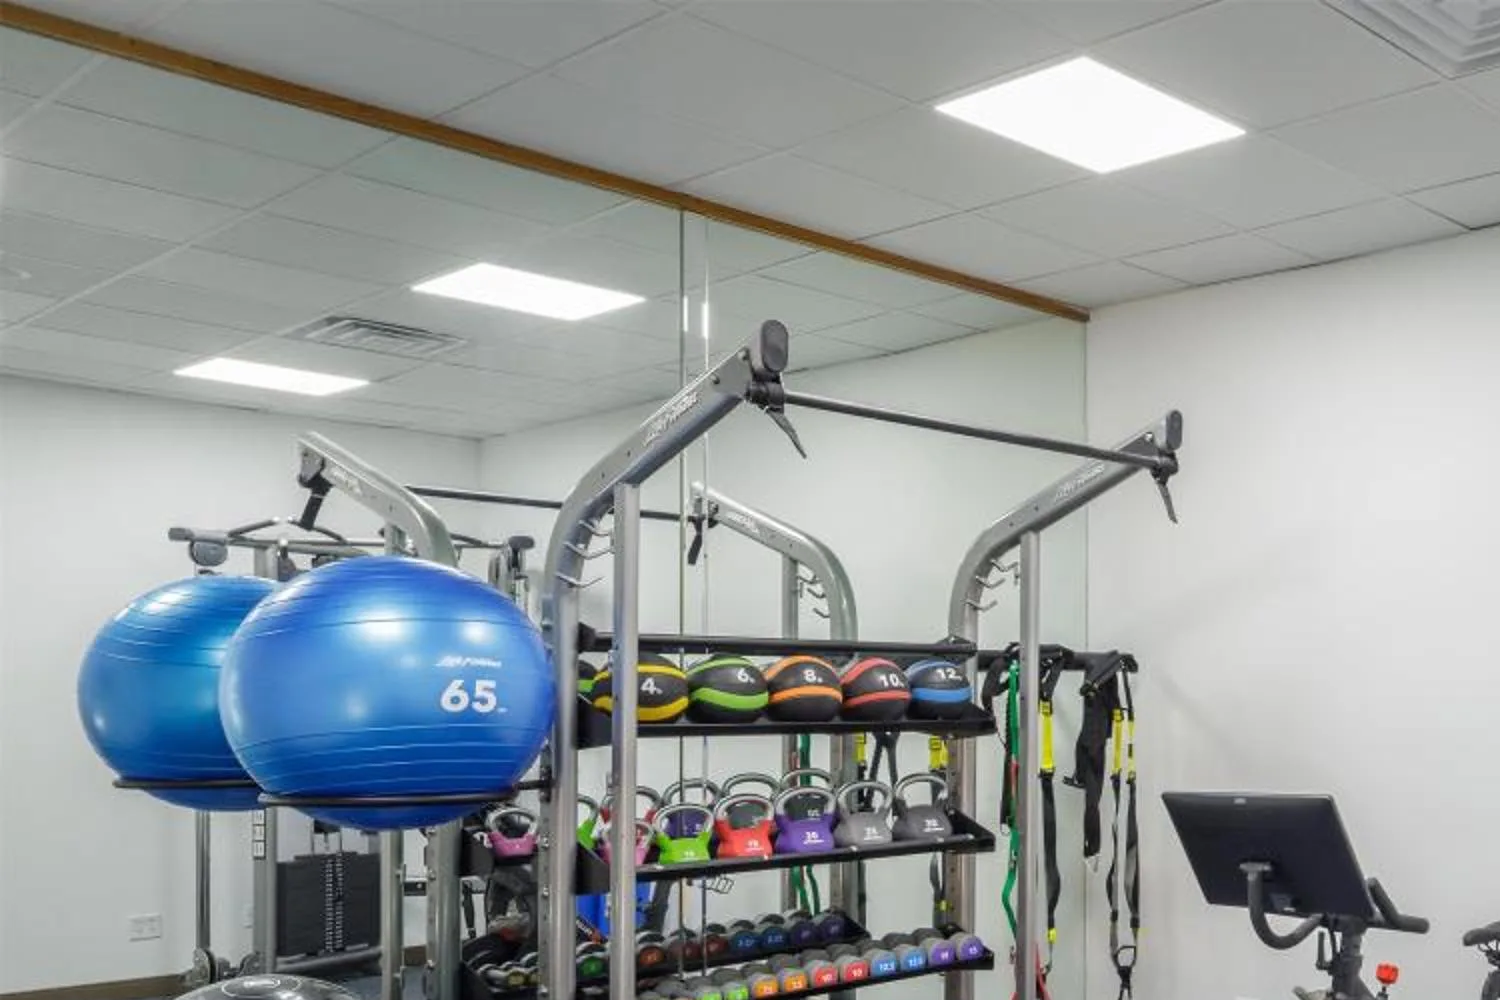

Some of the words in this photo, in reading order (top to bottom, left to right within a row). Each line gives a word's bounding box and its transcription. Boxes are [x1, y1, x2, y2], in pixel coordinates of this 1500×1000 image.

[736, 668, 750, 683] 6
[803, 669, 817, 683] 8
[639, 677, 656, 695] 4
[440, 679, 497, 713] 65
